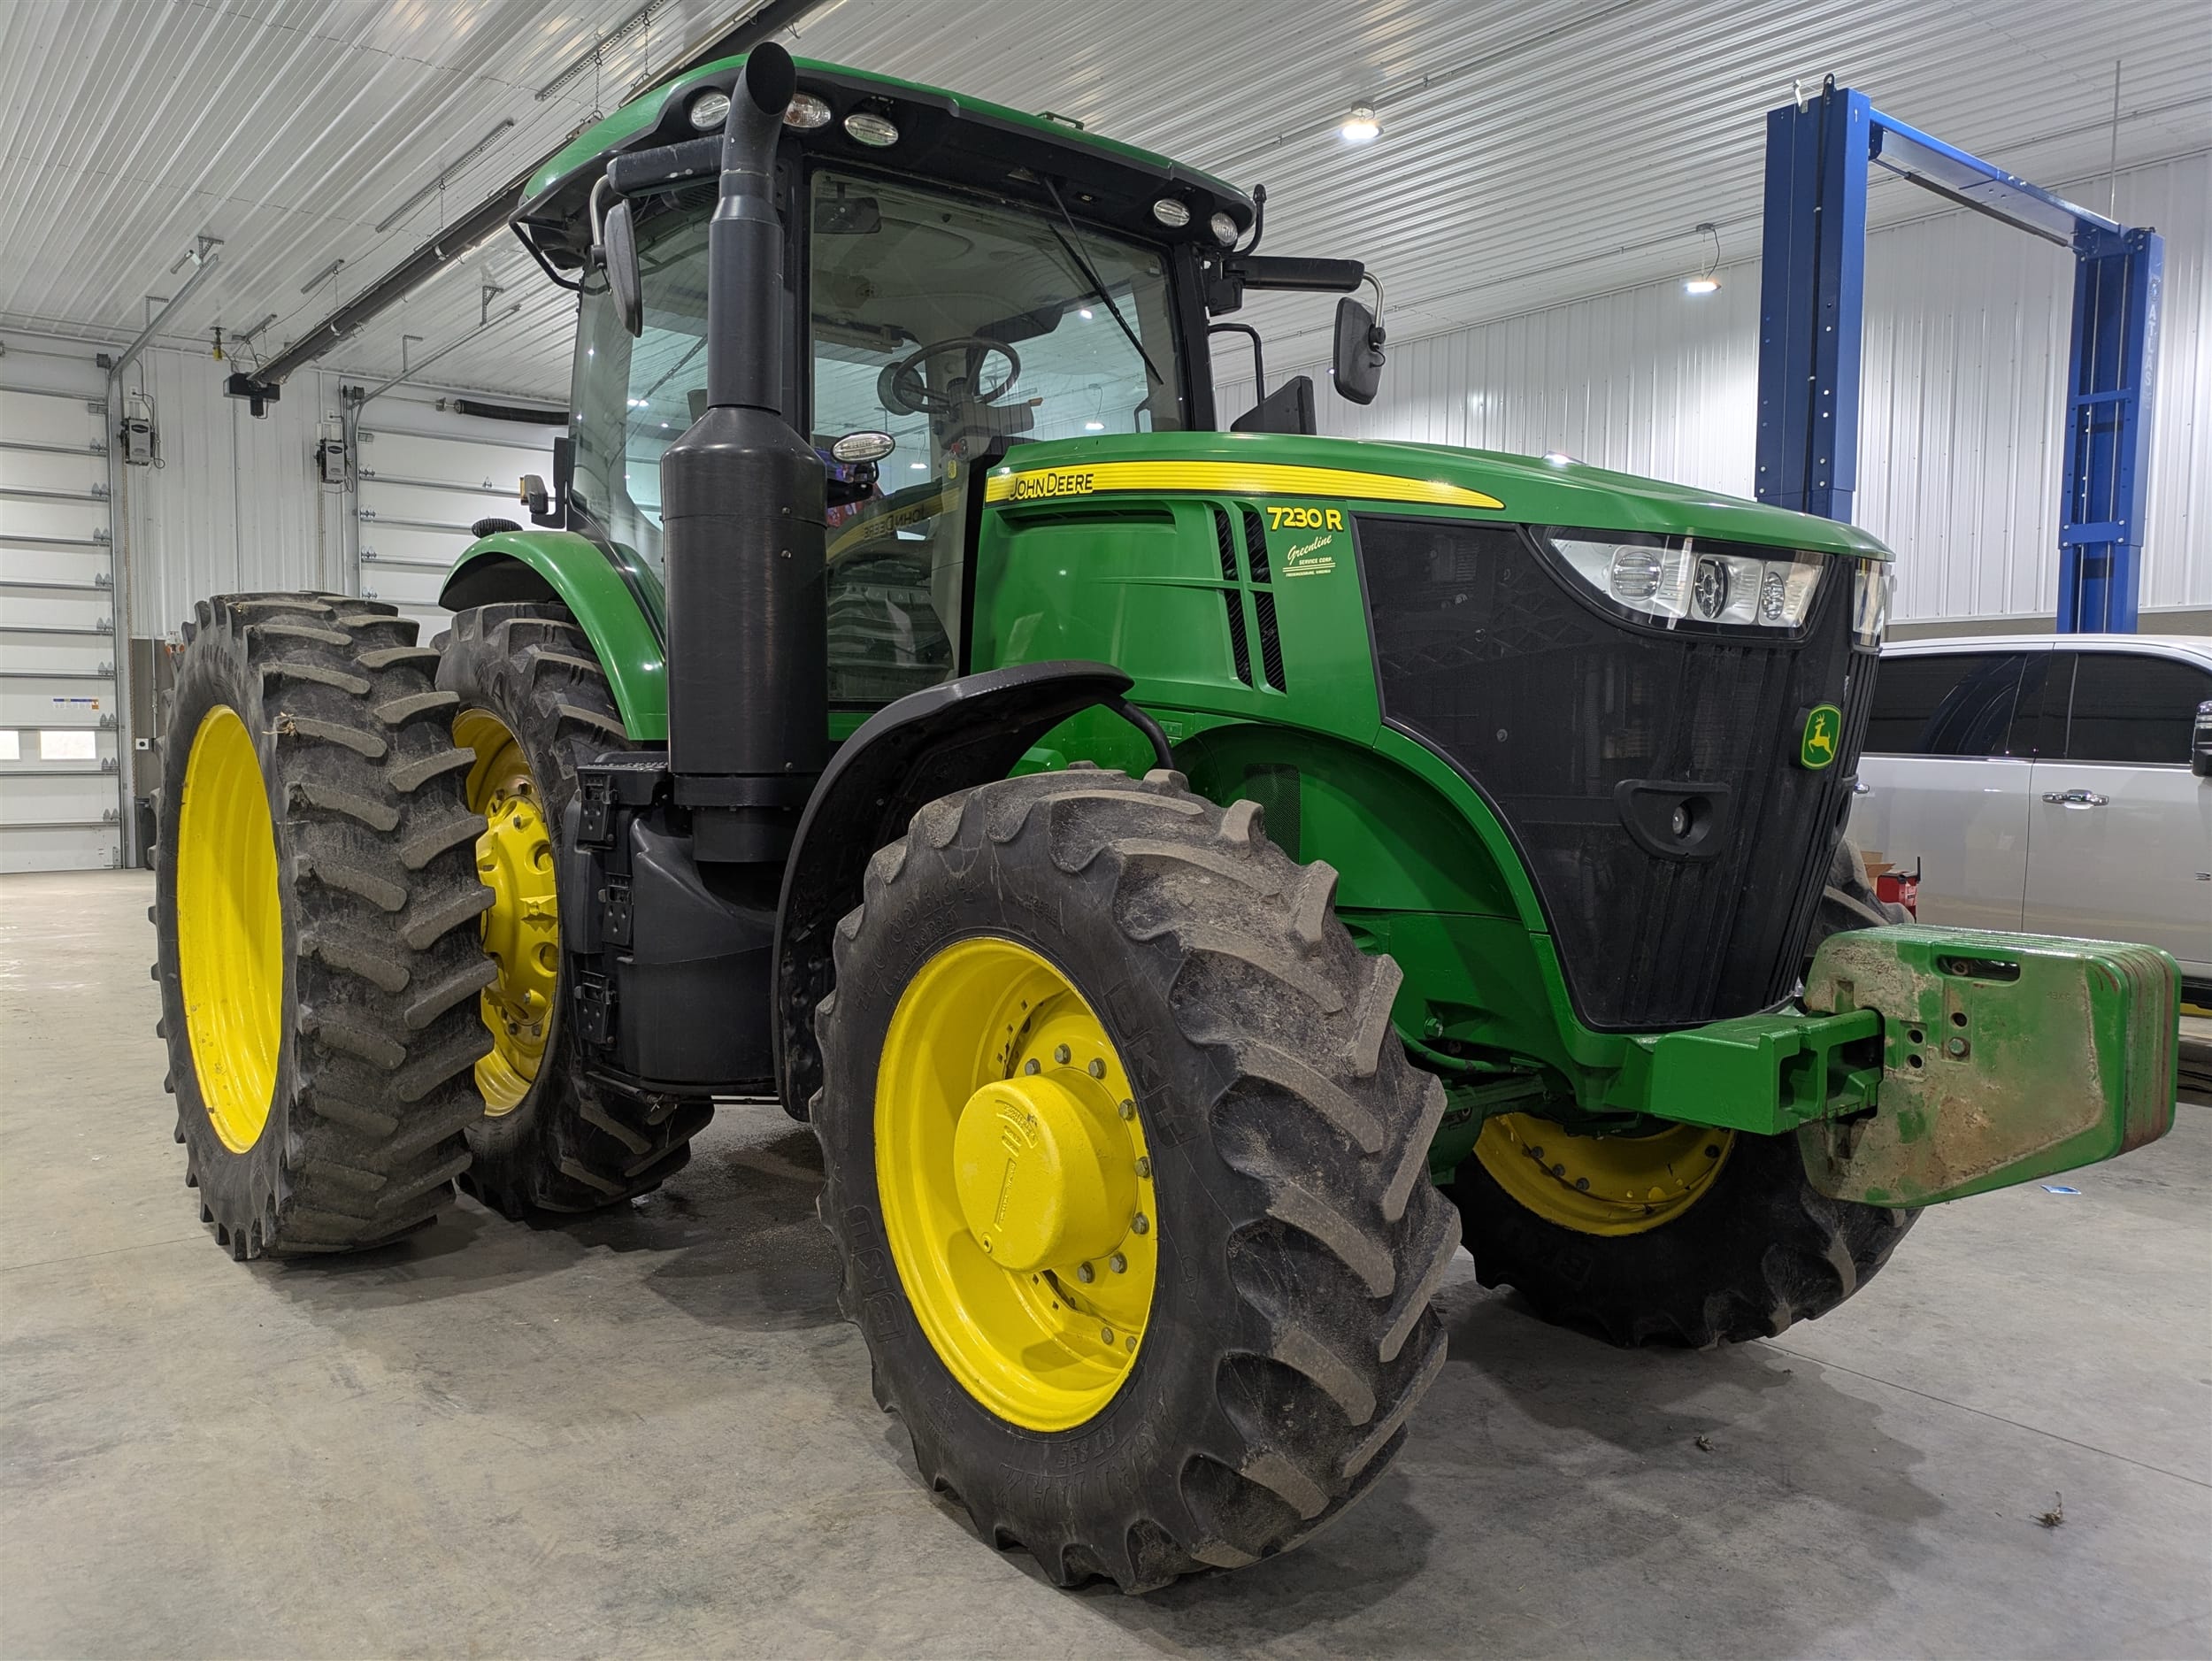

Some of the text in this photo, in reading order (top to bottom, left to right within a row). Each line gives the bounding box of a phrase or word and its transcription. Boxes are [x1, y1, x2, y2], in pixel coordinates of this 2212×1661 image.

[2144, 304, 2157, 386] ATLAS
[1010, 473, 1094, 498] JOHN DEERE
[1287, 534, 1333, 566] Greenline
